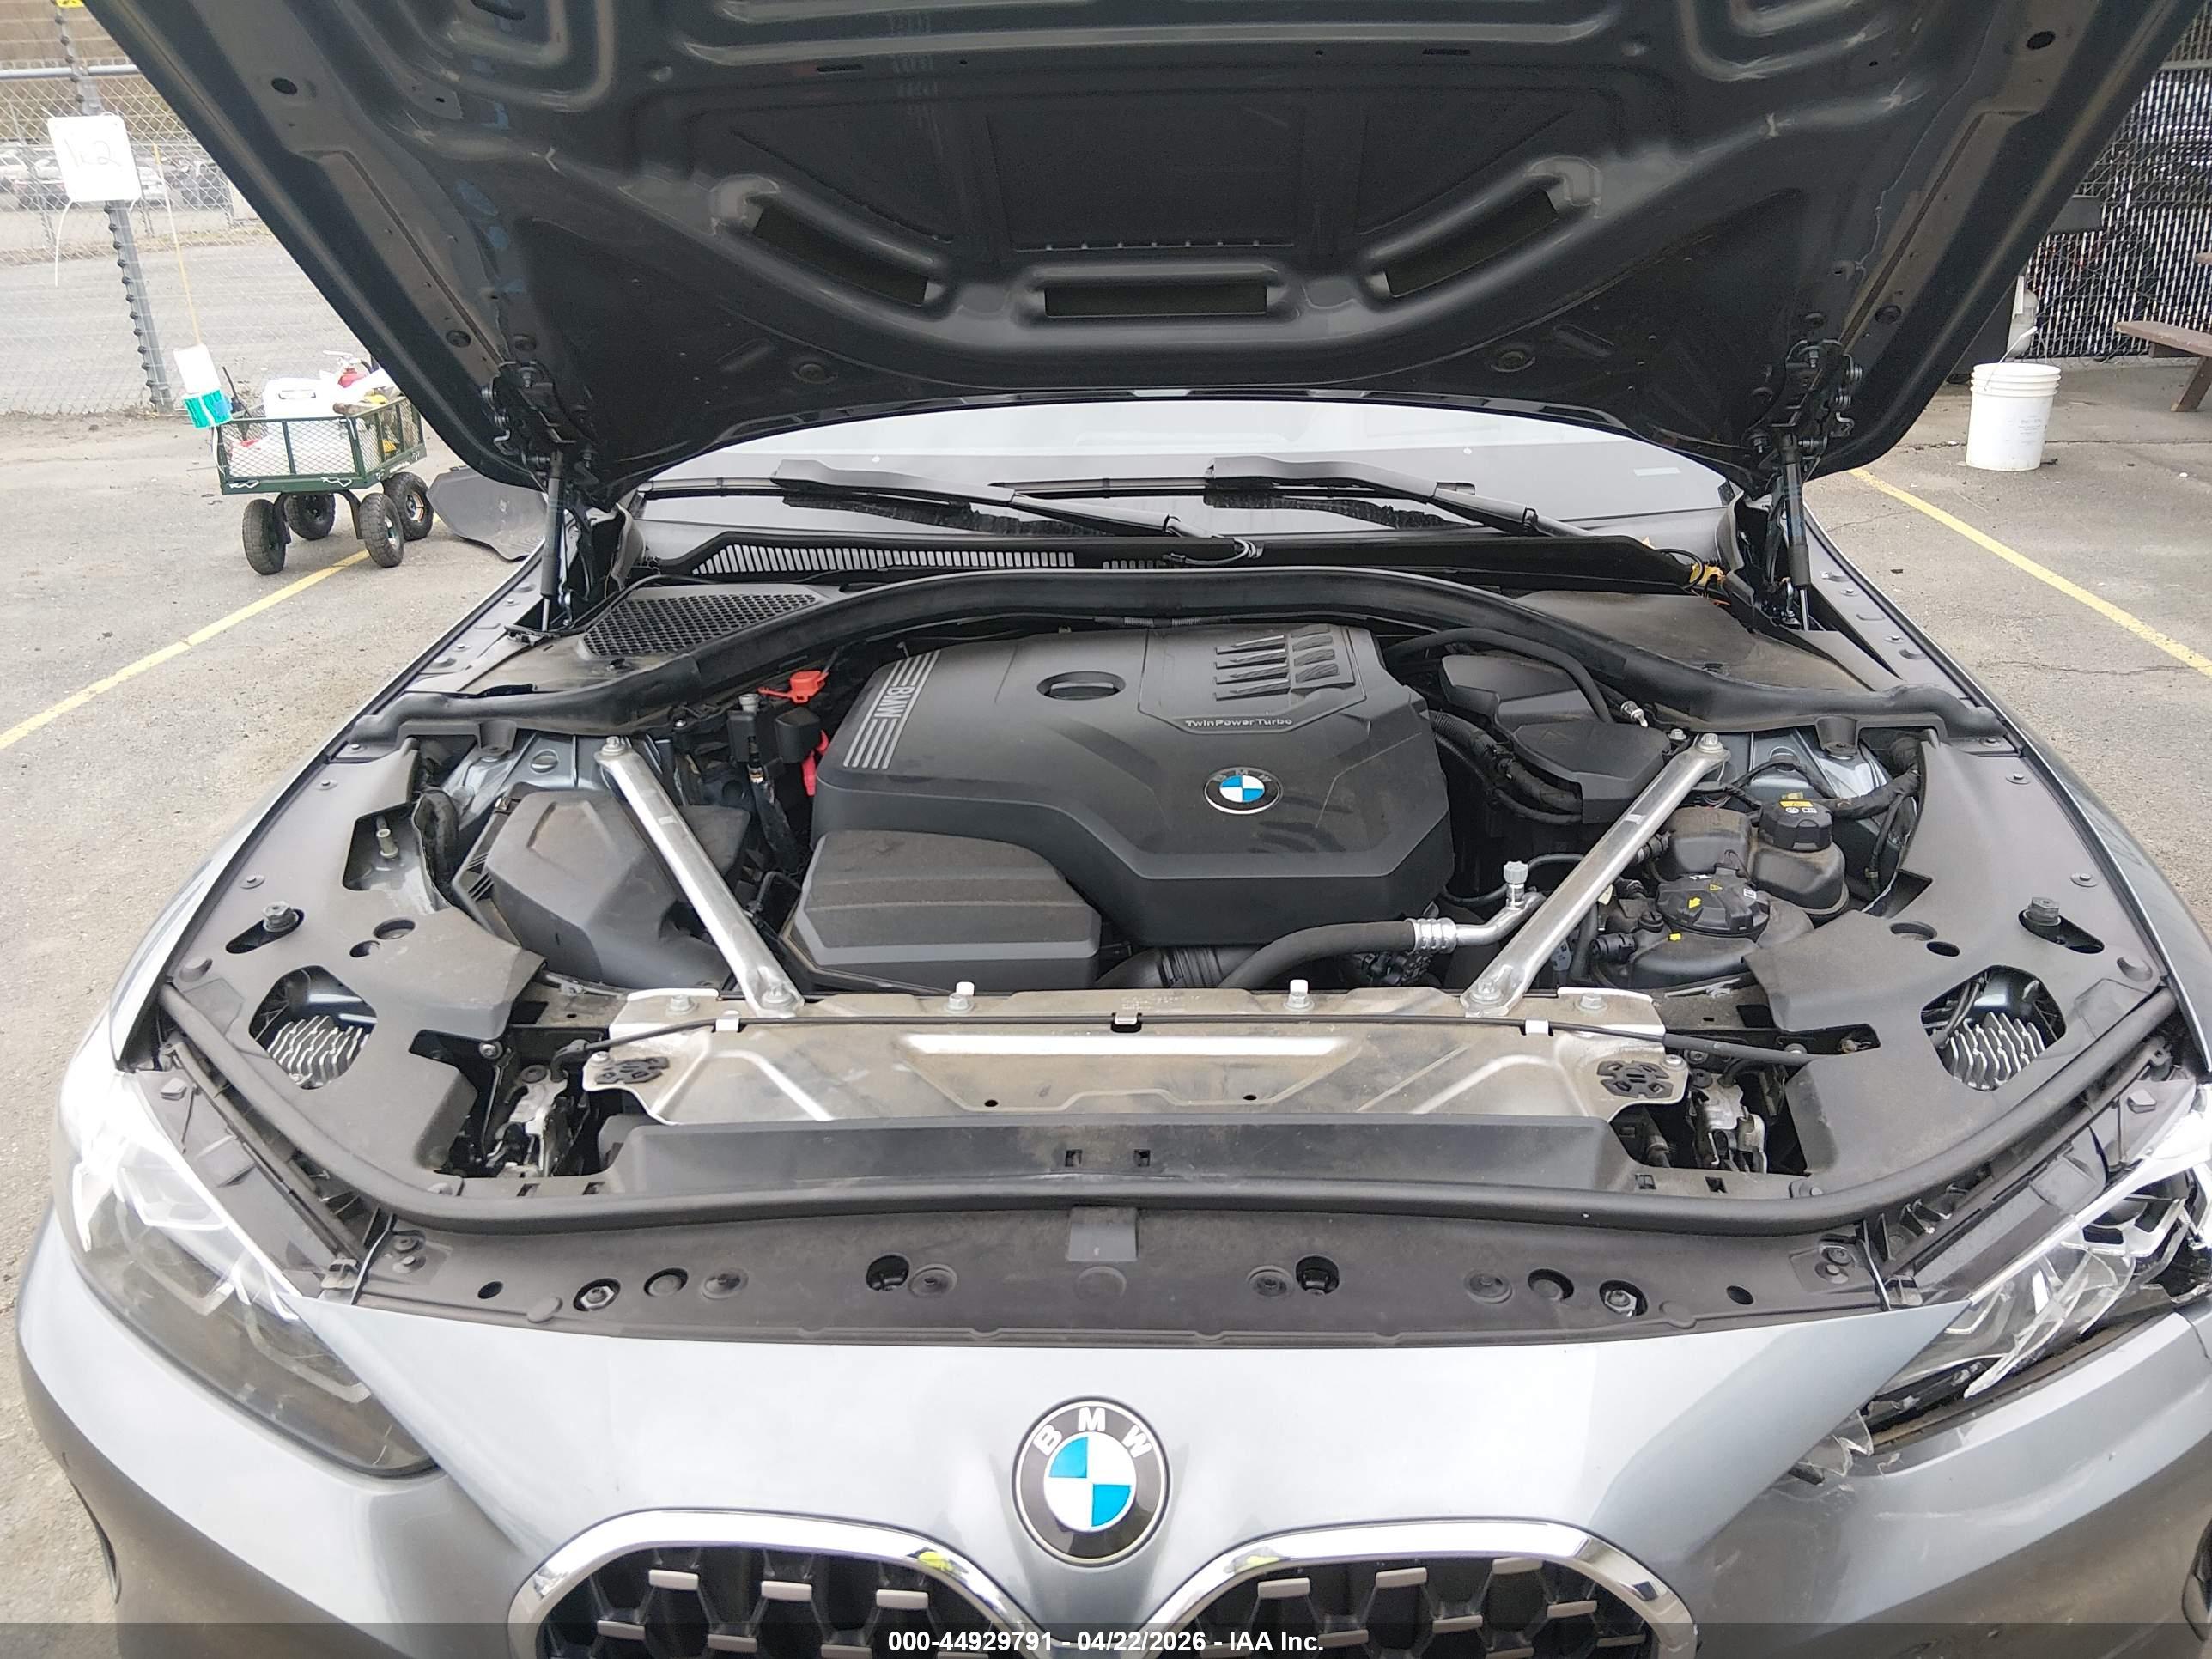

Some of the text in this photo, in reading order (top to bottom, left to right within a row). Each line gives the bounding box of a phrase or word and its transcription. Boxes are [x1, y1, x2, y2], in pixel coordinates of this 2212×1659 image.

[874, 686, 915, 717] BMW
[1212, 769, 1272, 782] BMW
[1032, 1407, 1152, 1458] BMW
